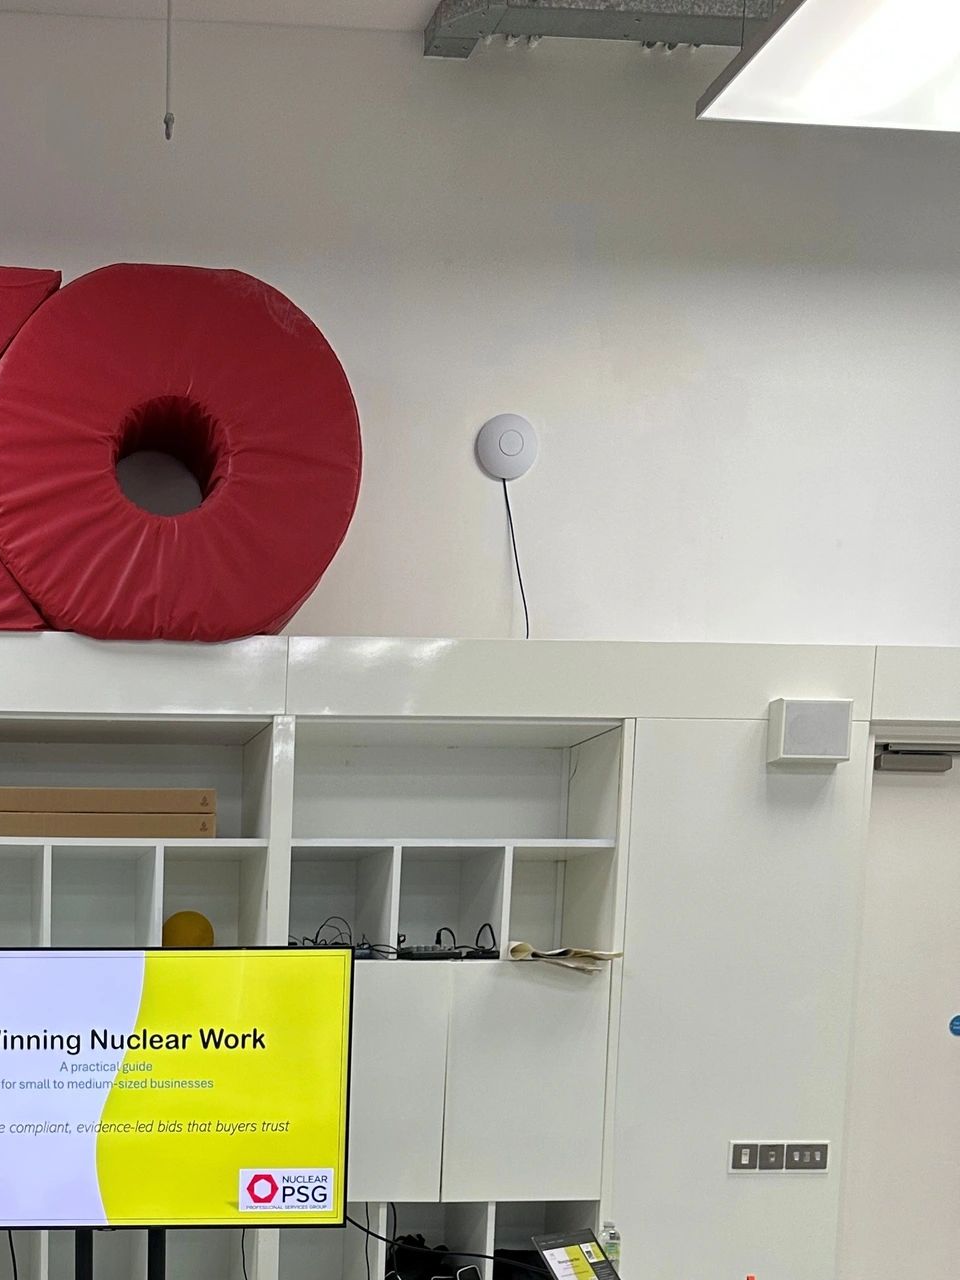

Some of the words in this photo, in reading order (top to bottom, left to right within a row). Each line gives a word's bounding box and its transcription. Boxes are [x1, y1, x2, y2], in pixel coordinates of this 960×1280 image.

[90, 1028, 192, 1050] Nuclear
[199, 1028, 266, 1050] Work
[60, 1062, 68, 1072] A
[71, 1061, 120, 1074] practical
[122, 1061, 153, 1074] guide
[1, 1079, 16, 1090] for
[19, 1079, 50, 1090] small
[53, 1080, 64, 1090] to
[67, 1078, 147, 1089] medium-sized
[150, 1078, 214, 1089] businesses
[9, 1121, 72, 1136] compliant,
[76, 1121, 154, 1133] evidence-led
[157, 1121, 183, 1133] bids
[188, 1121, 212, 1132] that
[216, 1120, 257, 1135] buyers
[262, 1121, 290, 1132] trust
[282, 1175, 328, 1184] NUCLEAR
[282, 1186, 327, 1203] PSG
